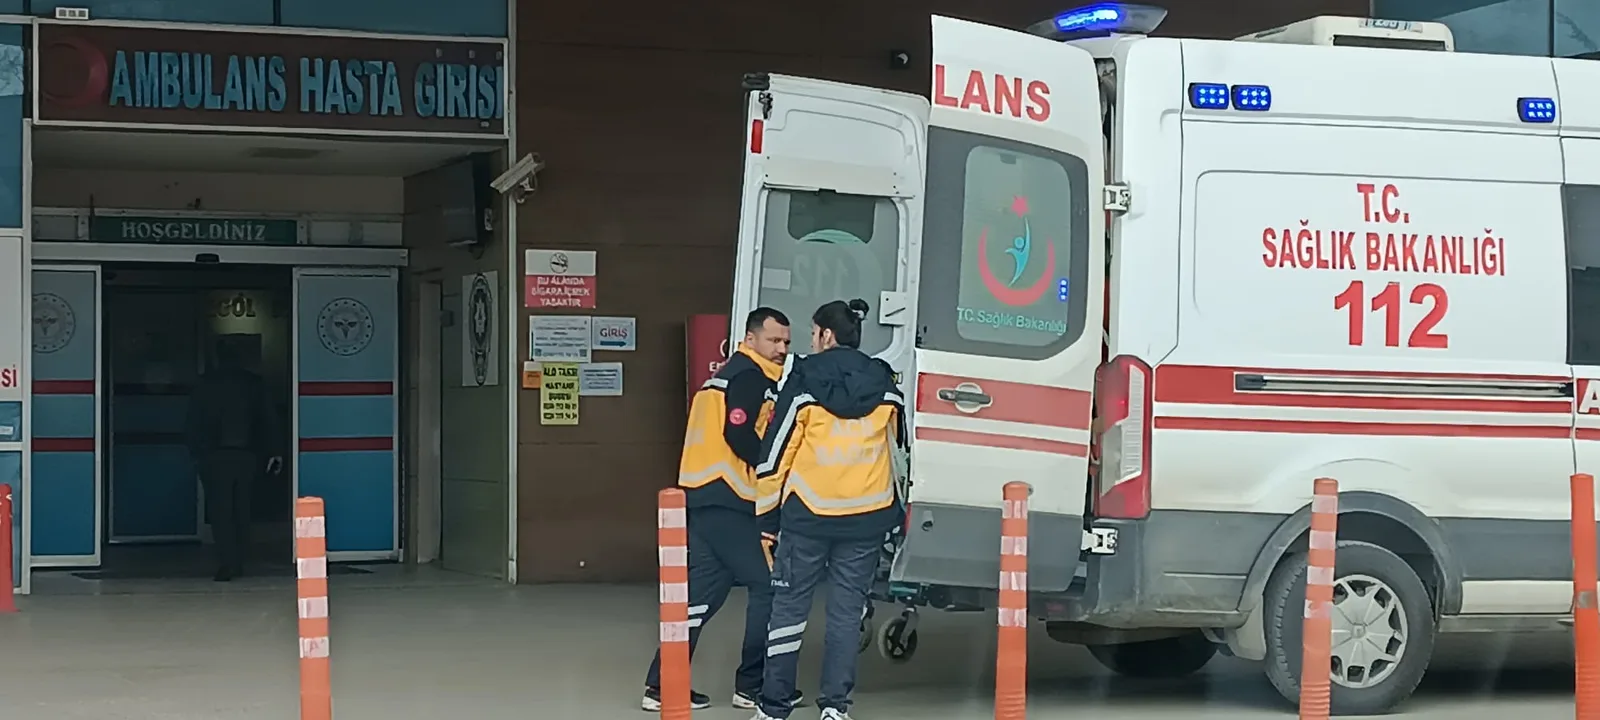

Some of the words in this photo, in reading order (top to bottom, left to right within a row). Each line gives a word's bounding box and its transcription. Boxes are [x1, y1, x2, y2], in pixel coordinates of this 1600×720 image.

[109, 50, 287, 112] AMBULANS
[300, 57, 404, 116] HASTA
[414, 49, 504, 127] GİRİŞİ
[935, 64, 1051, 122] LANS
[121, 220, 267, 242] HOŞGELDİNİZ
[1357, 183, 1410, 224] T.C.
[1262, 219, 1357, 271] SAĞLIK
[1366, 228, 1506, 277] BAKANLIĞI
[600, 326, 628, 339] GİRİŞ
[1334, 280, 1449, 349] 112
